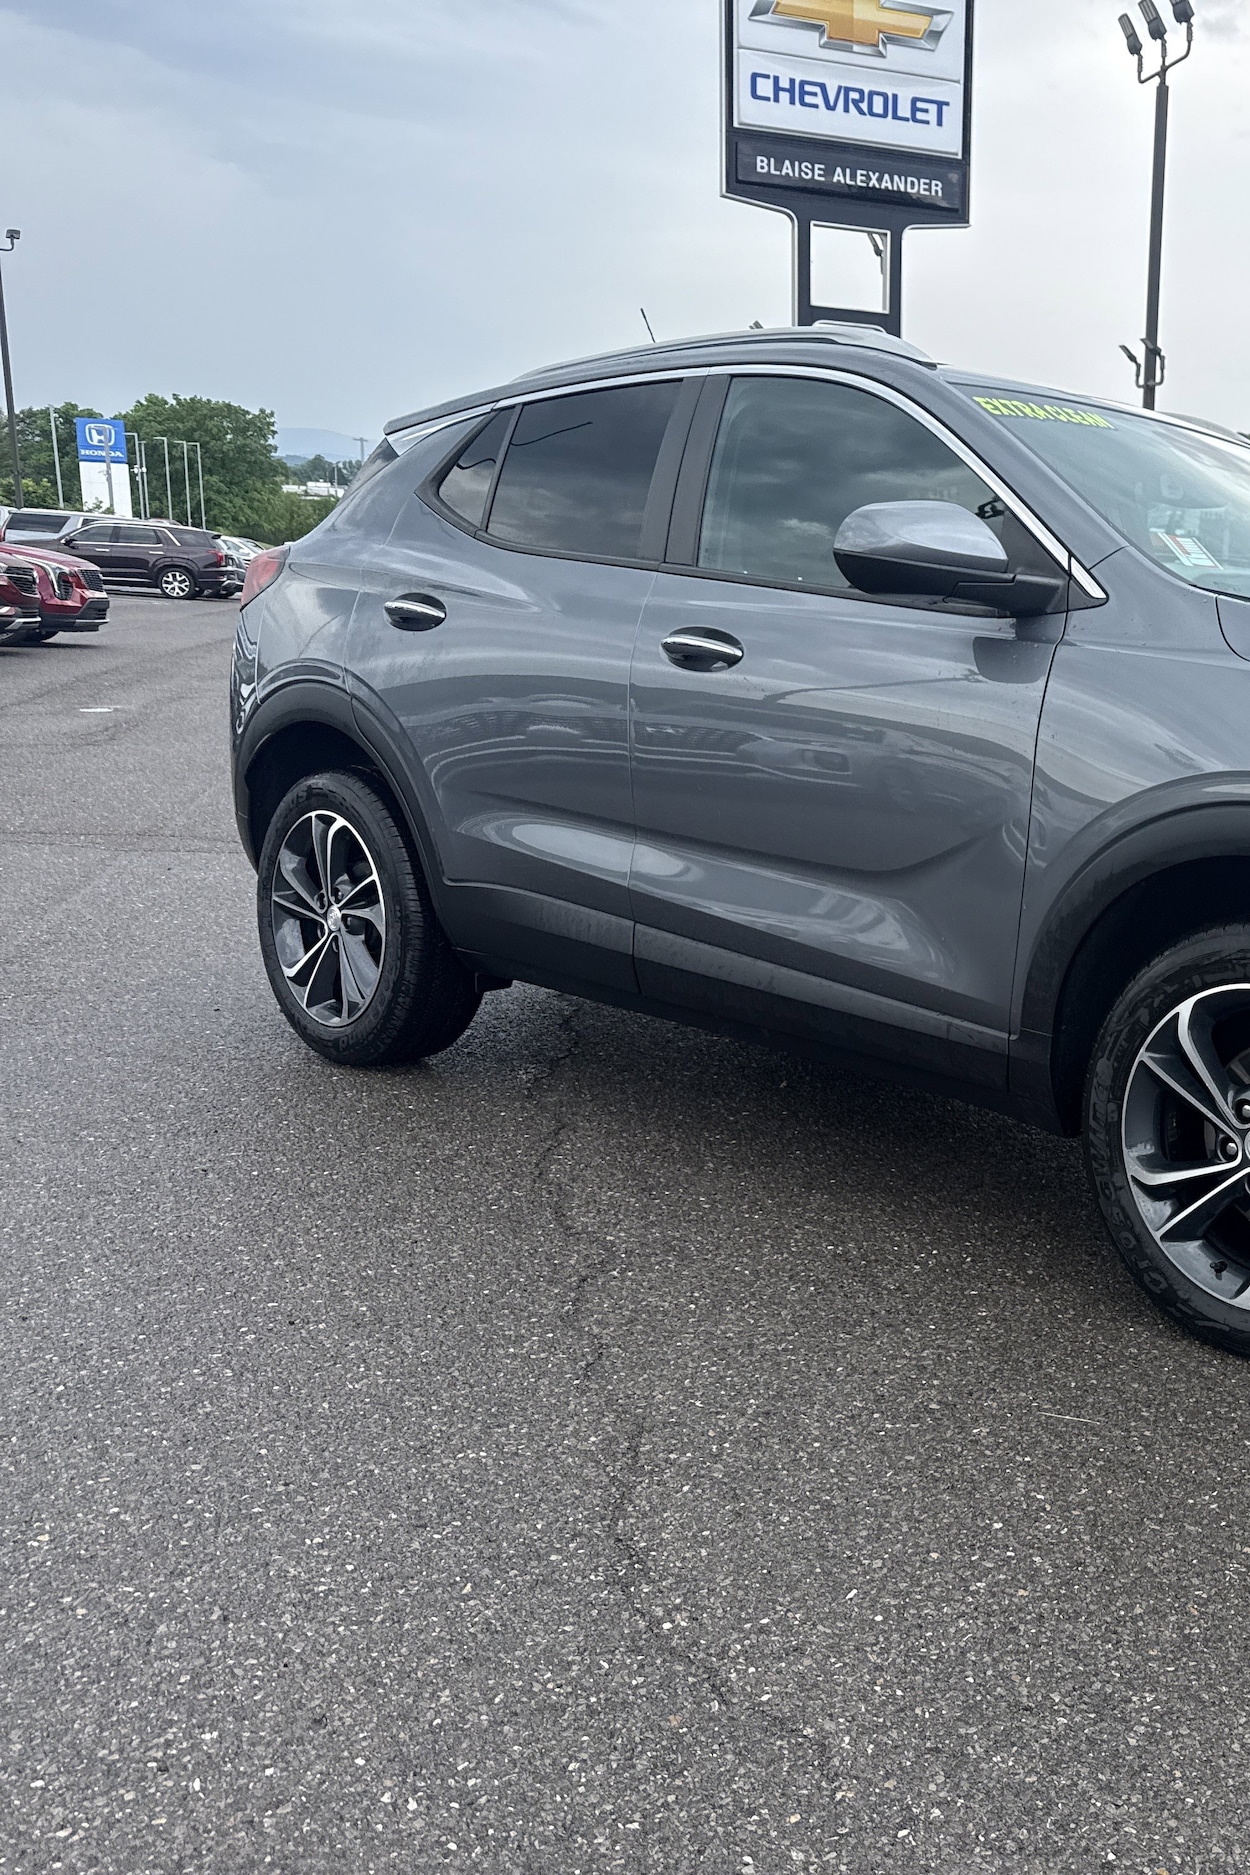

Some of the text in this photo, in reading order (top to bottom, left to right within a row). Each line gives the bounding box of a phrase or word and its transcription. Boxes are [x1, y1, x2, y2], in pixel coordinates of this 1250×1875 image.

[750, 71, 950, 127] CHEVROLET
[756, 155, 943, 197] BLAISE ALEXANDER
[80, 449, 124, 458] HONDA
